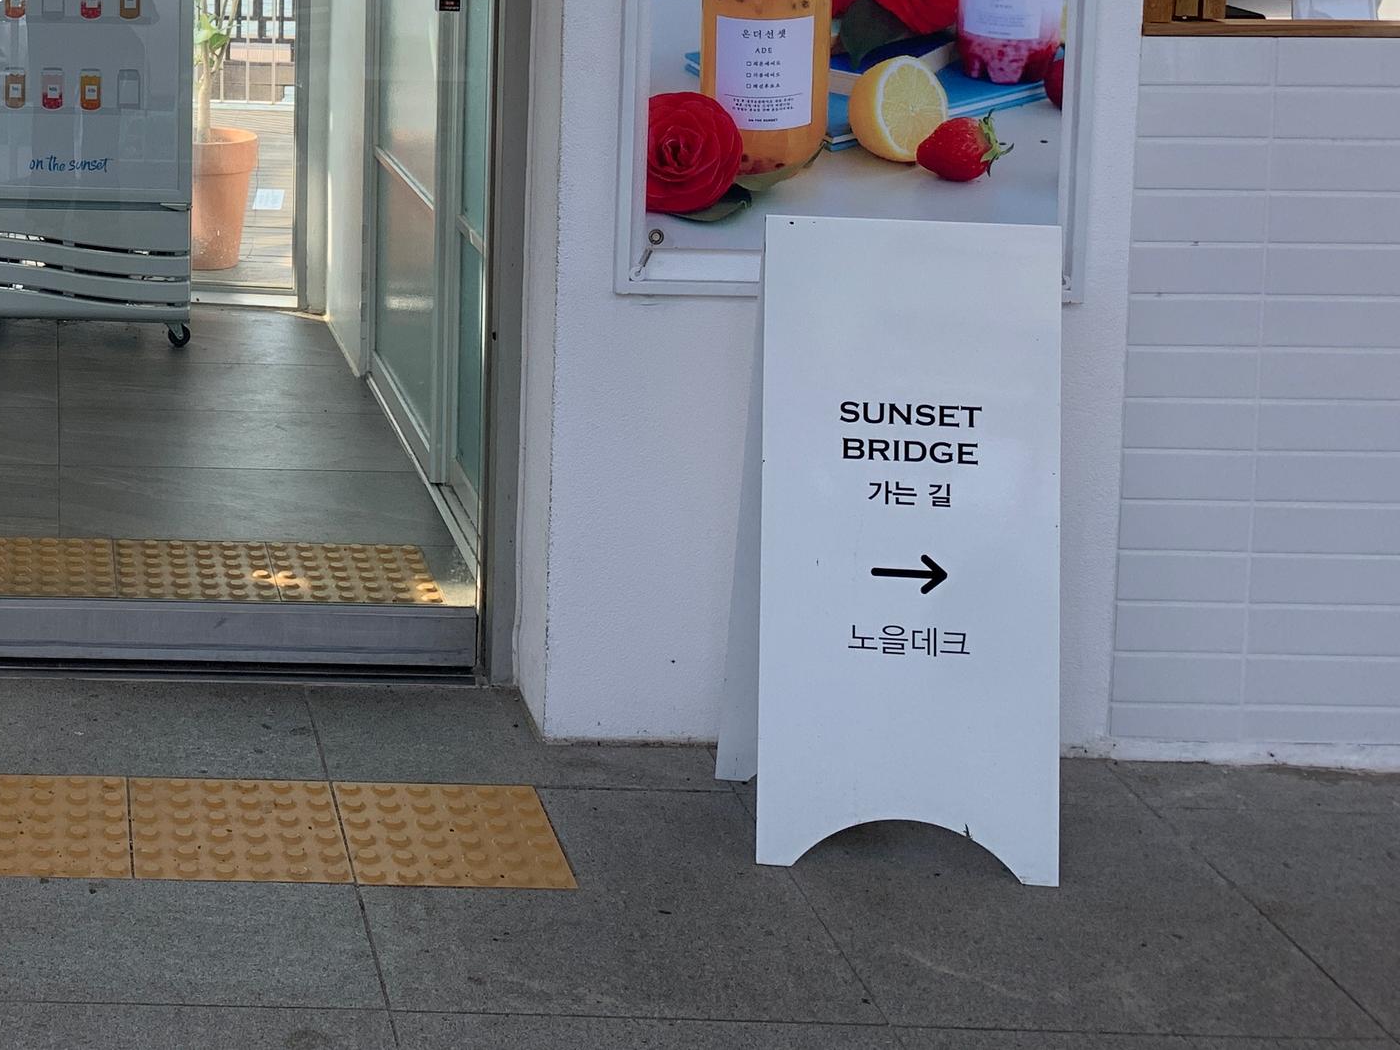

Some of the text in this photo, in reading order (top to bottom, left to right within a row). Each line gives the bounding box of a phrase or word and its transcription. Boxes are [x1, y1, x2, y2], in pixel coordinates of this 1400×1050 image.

[742, 29, 786, 39] 온더선셋
[28, 159, 43, 170] on
[68, 158, 115, 173] sunset
[839, 400, 983, 428] SUNSET
[842, 437, 979, 466] BRIDGE
[868, 480, 951, 508] 가는 길
[848, 624, 970, 657] 노을데크
